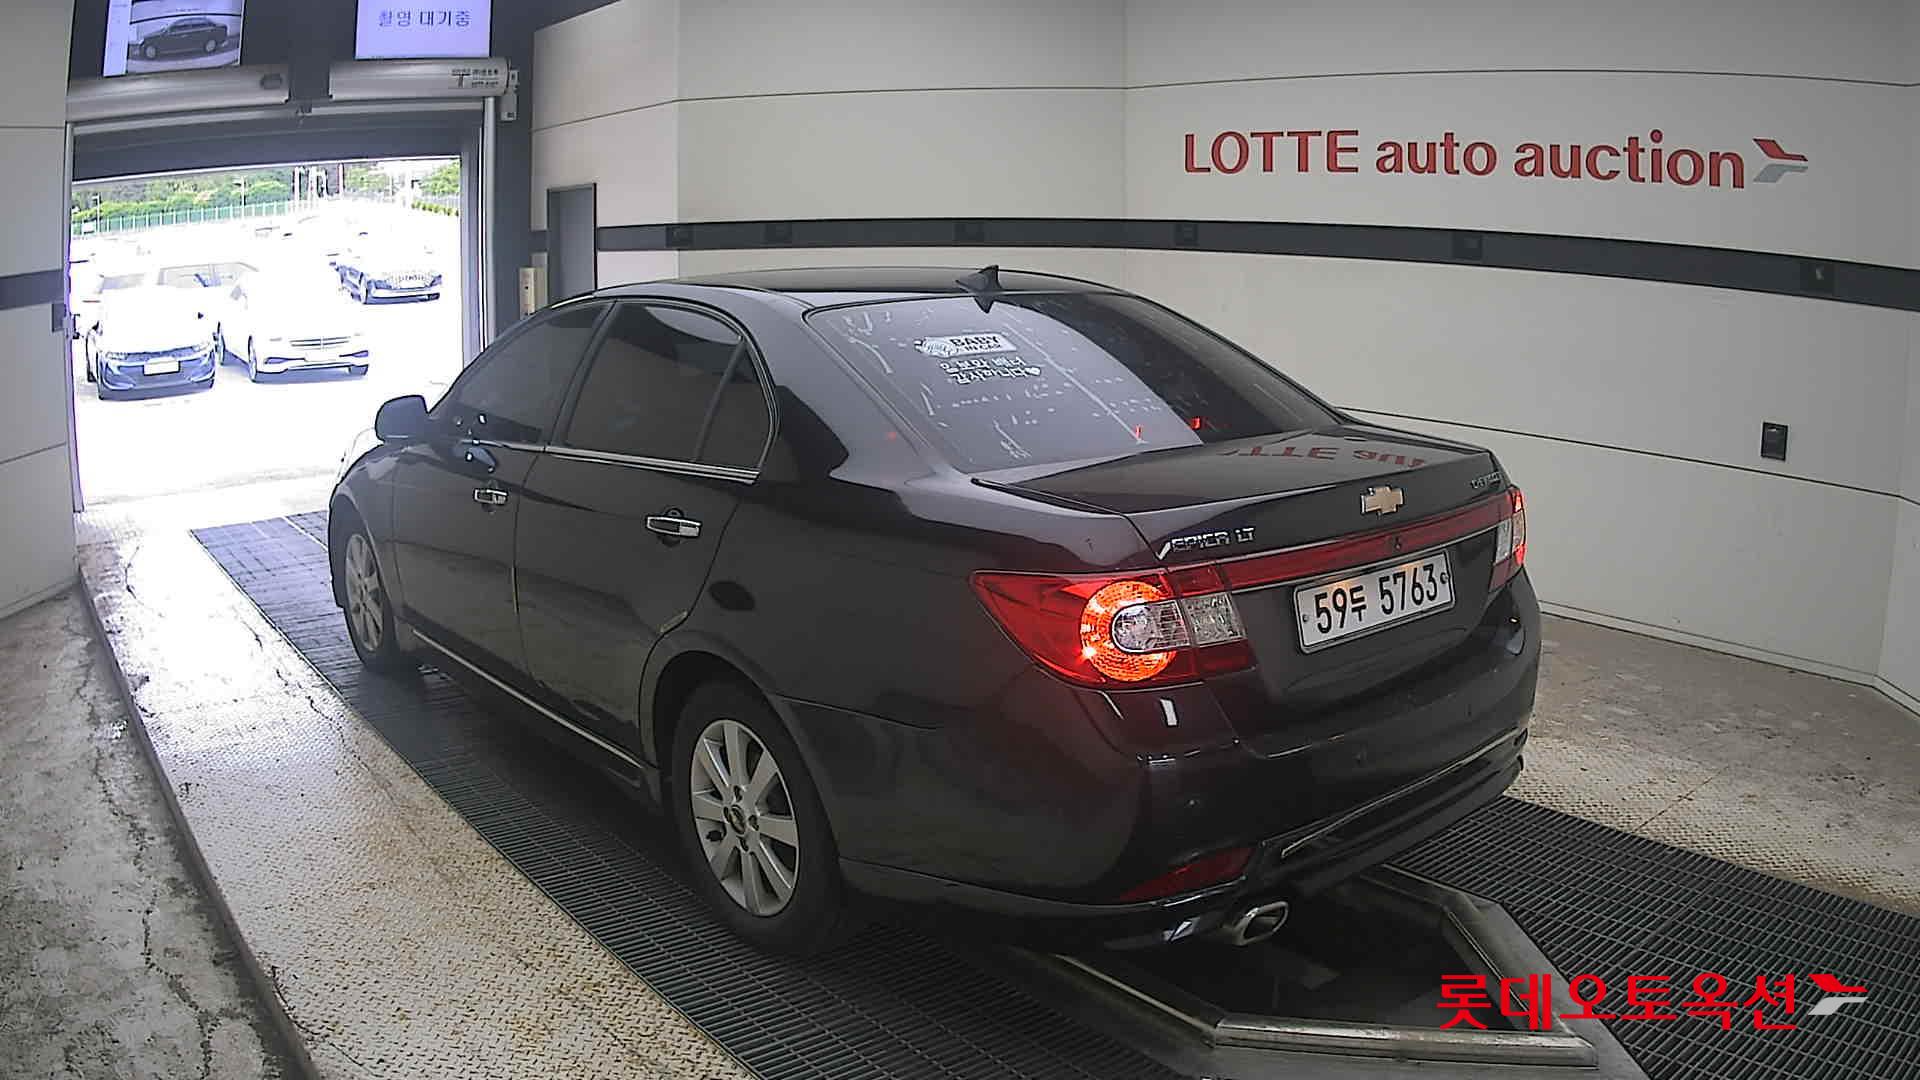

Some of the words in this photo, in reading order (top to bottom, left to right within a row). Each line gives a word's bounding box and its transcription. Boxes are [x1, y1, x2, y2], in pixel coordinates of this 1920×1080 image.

[420, 10, 471, 28] 대기중
[1184, 130, 1359, 174] LOTTE
[1375, 132, 1497, 176] auto
[1514, 130, 1745, 189] auction
[949, 335, 1000, 347] BABY
[1314, 585, 1367, 634] 59두
[1378, 563, 1438, 615] 5763
